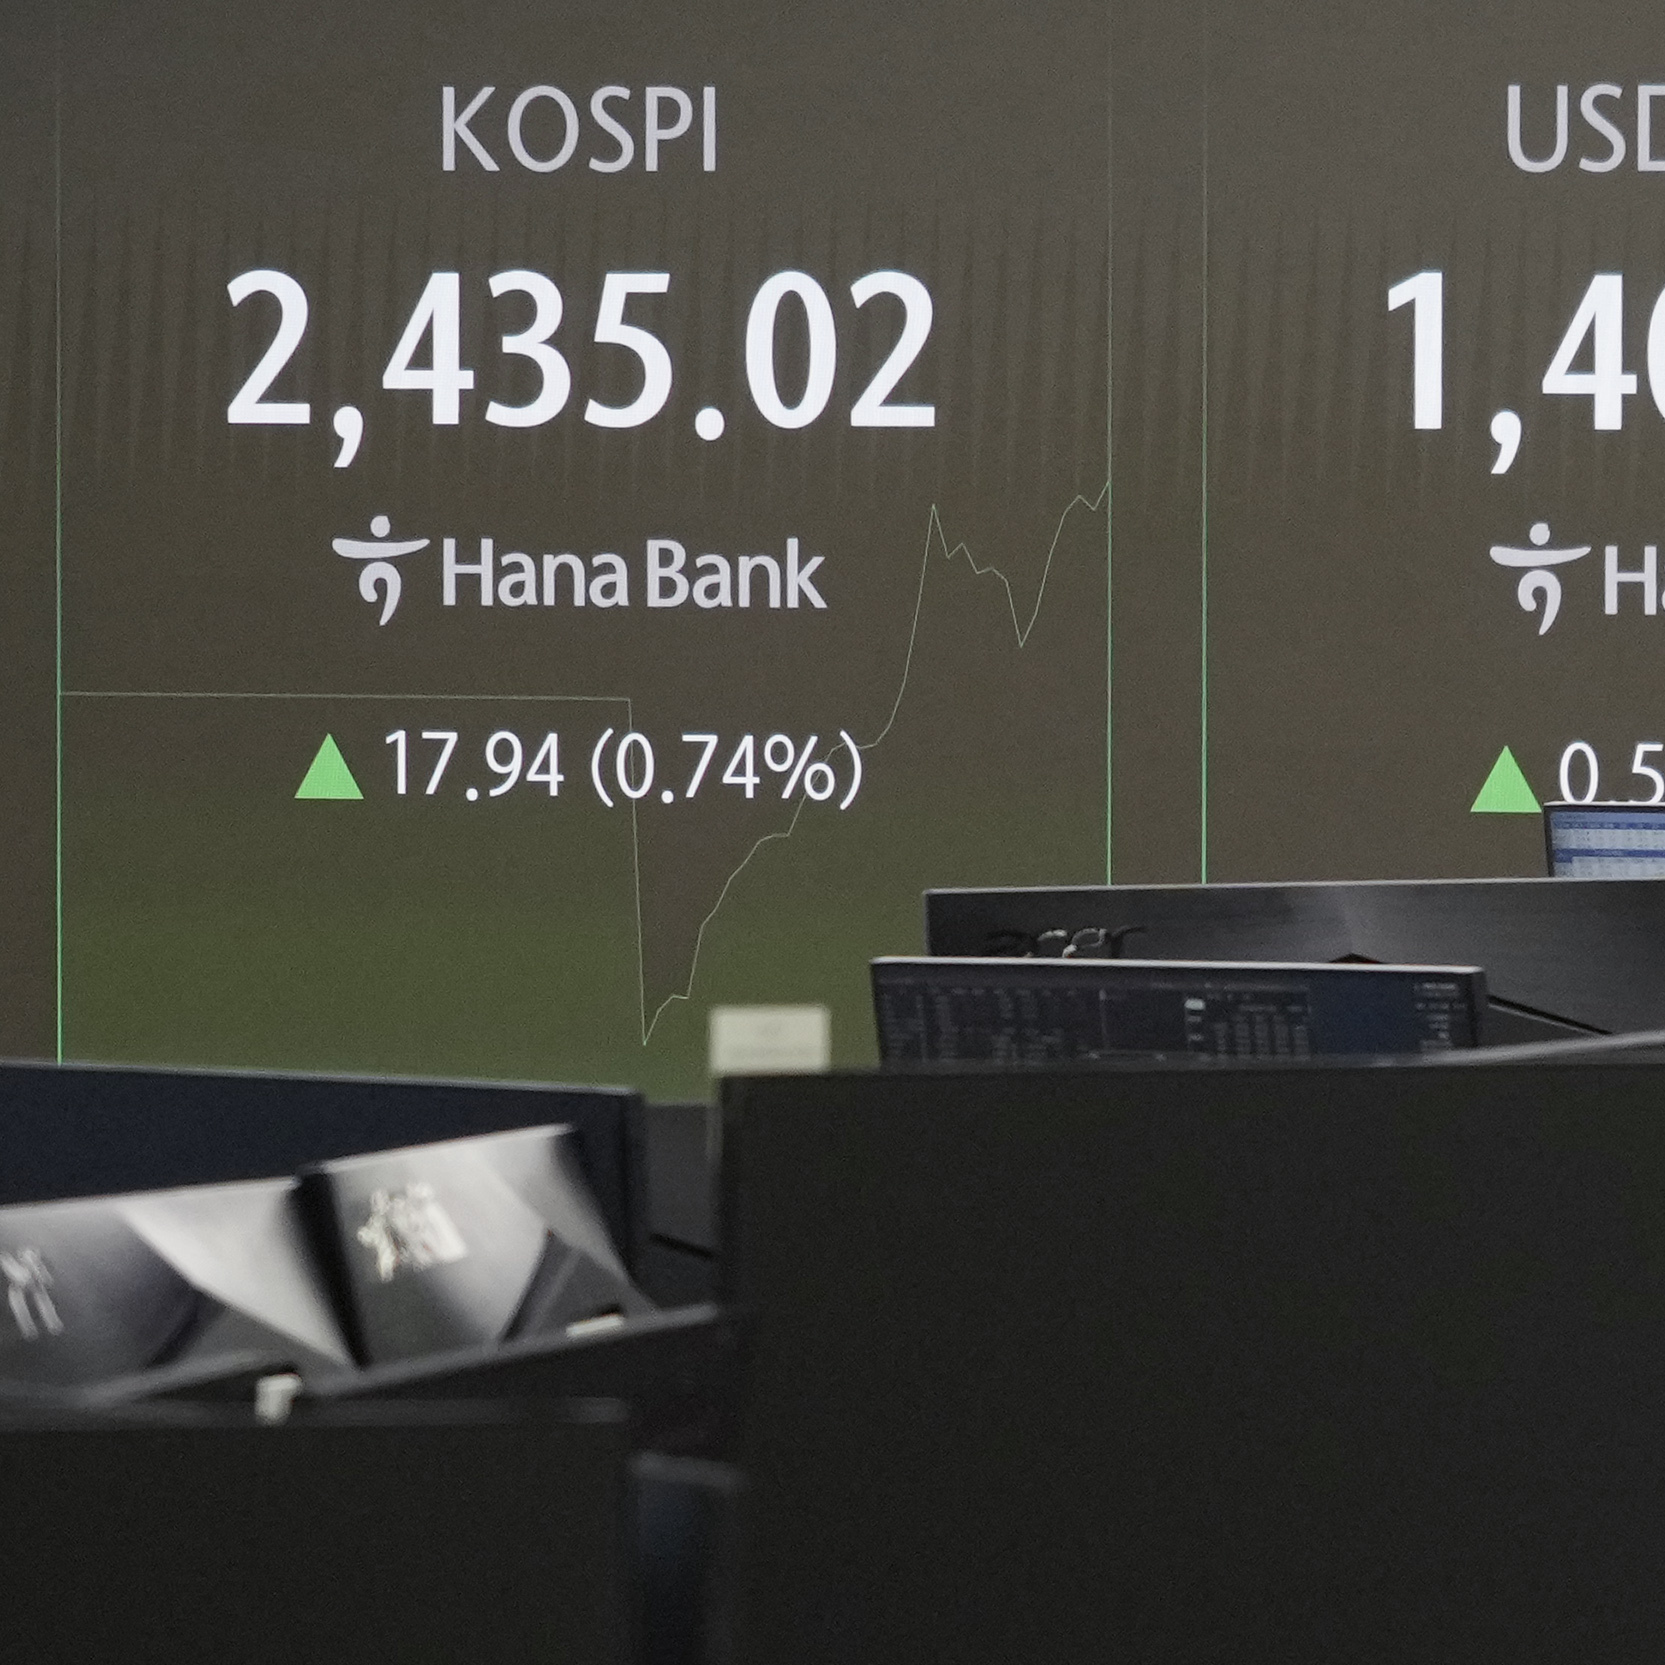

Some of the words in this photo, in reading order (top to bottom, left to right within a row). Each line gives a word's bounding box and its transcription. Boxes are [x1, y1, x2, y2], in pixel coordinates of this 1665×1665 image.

[442, 84, 716, 173] KOSPI
[226, 269, 936, 468] 2,435.02
[442, 537, 629, 608] Hana
[646, 537, 828, 609] Bank
[385, 729, 565, 802] 17.94
[591, 727, 862, 811] (0.74%)
